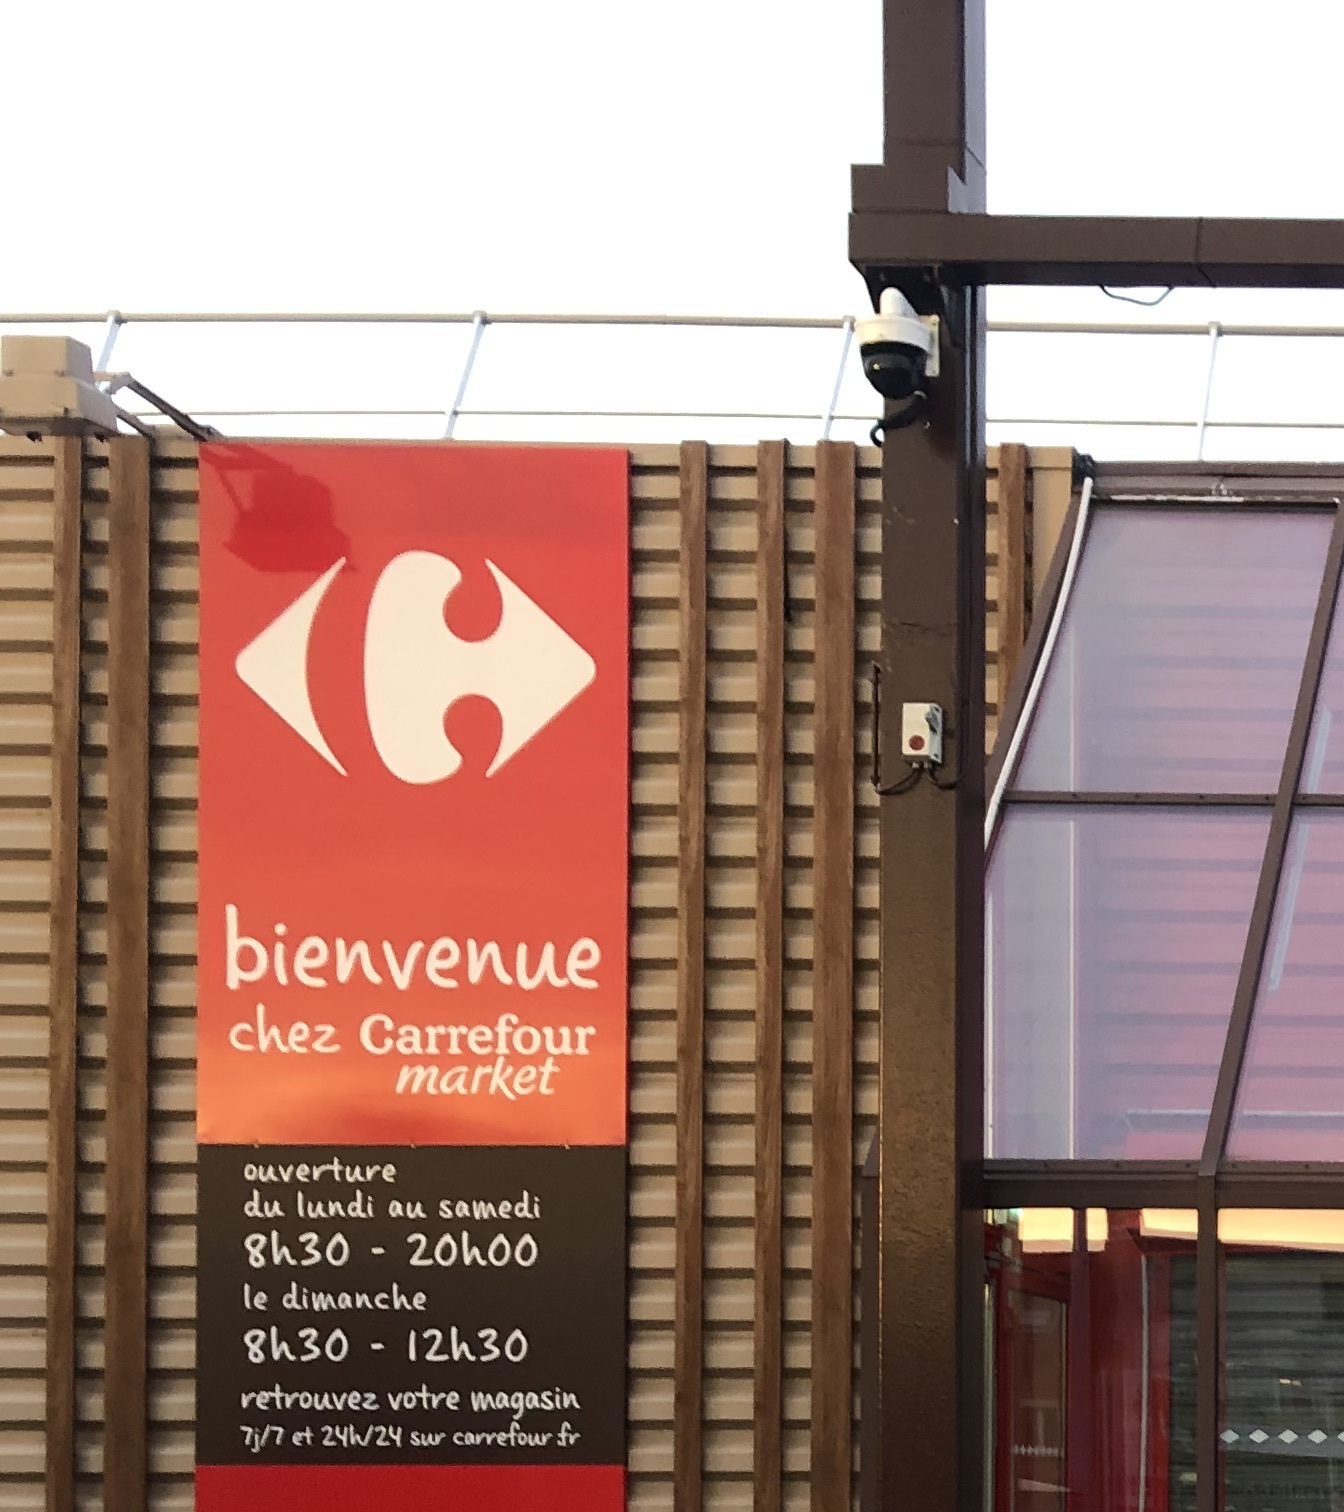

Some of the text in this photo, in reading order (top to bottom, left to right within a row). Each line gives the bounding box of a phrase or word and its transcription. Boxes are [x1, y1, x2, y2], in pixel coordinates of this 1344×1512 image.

[225, 903, 601, 990] bienvenue
[229, 1003, 596, 1056] chez Carrefour
[395, 1056, 561, 1100] market
[243, 1157, 397, 1184] ouverture
[243, 1189, 541, 1221] du lundi au samedi
[243, 1230, 350, 1268] 8h30
[405, 1232, 539, 1268] 20h00
[243, 1283, 428, 1311] le dimanche
[243, 1326, 349, 1364] 8h30
[407, 1326, 529, 1363] 12h30
[240, 1384, 580, 1420] retrouvez votre magasin
[239, 1421, 581, 1452] 7j/7 et 24h/24 sur carrefour.fr
